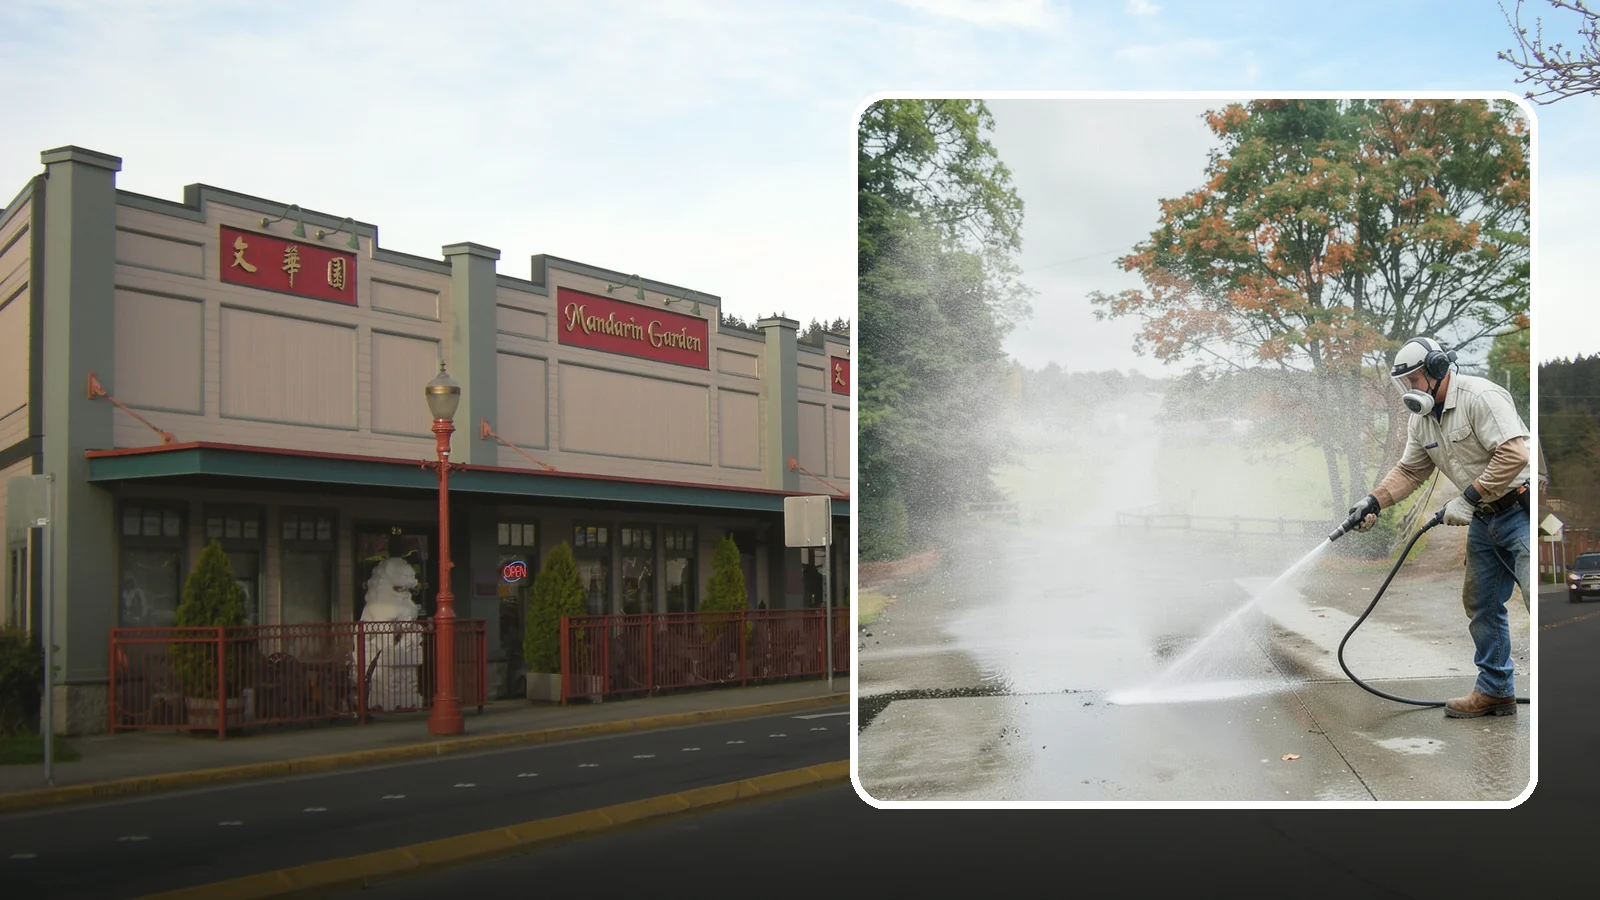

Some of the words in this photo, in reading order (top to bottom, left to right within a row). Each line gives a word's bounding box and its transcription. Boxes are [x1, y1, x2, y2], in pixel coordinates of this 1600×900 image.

[565, 302, 644, 341] Mandarin
[648, 321, 702, 352] Garden
[503, 565, 527, 578] OPEN
